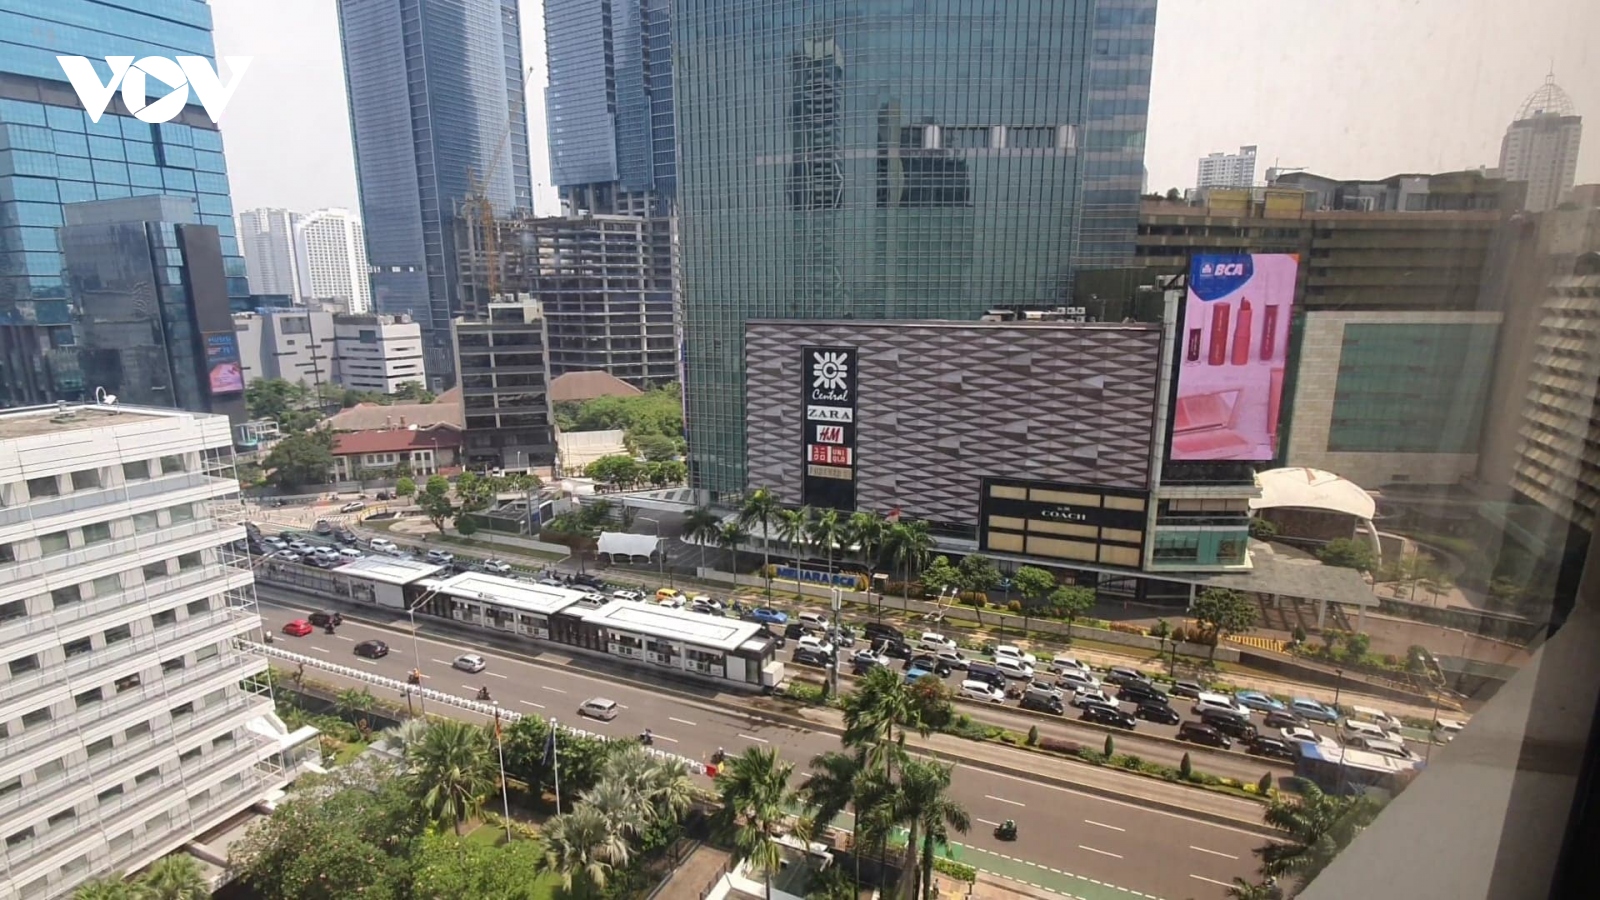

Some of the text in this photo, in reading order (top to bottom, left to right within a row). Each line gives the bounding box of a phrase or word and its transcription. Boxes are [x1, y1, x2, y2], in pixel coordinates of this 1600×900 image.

[1214, 263, 1244, 276] BCA
[812, 388, 848, 401] Central
[808, 408, 851, 420] ZARA
[1041, 510, 1086, 521] COACH
